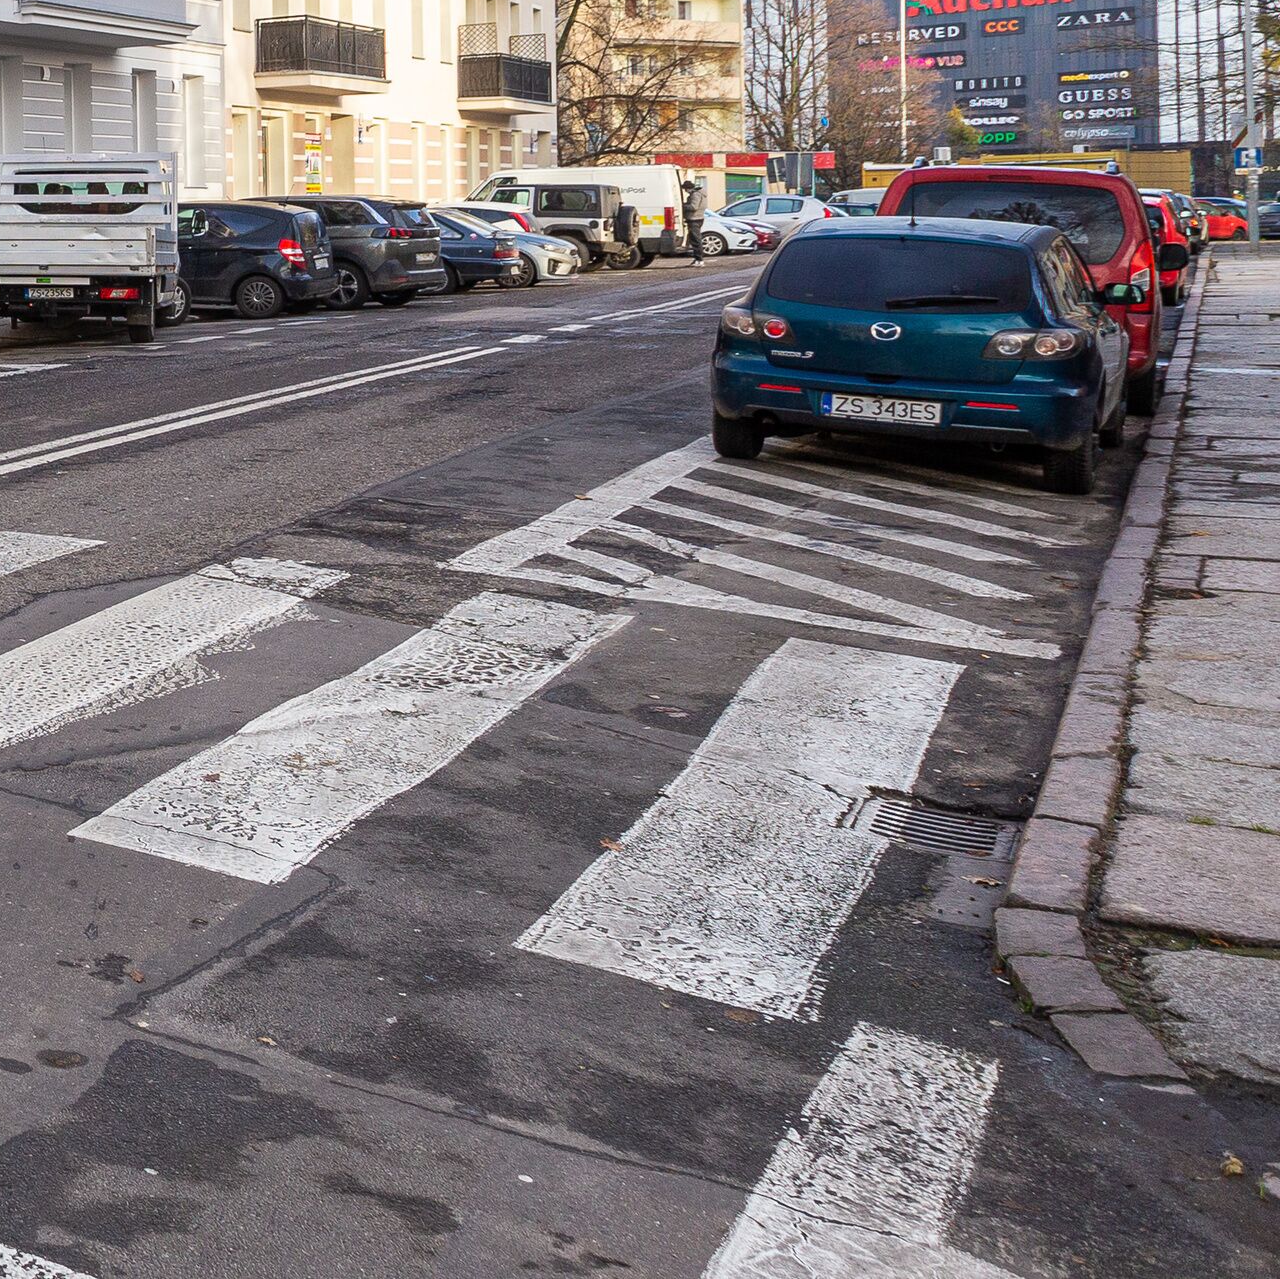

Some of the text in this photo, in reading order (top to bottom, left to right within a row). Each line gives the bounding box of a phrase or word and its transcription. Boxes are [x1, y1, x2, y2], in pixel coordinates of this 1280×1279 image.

[984, 19, 1019, 33] CCC
[1057, 11, 1132, 27] ZARA
[955, 76, 1022, 91] MOHITO
[969, 96, 1008, 109] sinsay
[1058, 87, 1132, 104] GUESS
[1062, 107, 1134, 120] GO SPORT
[835, 396, 937, 422] ZS 343ES
